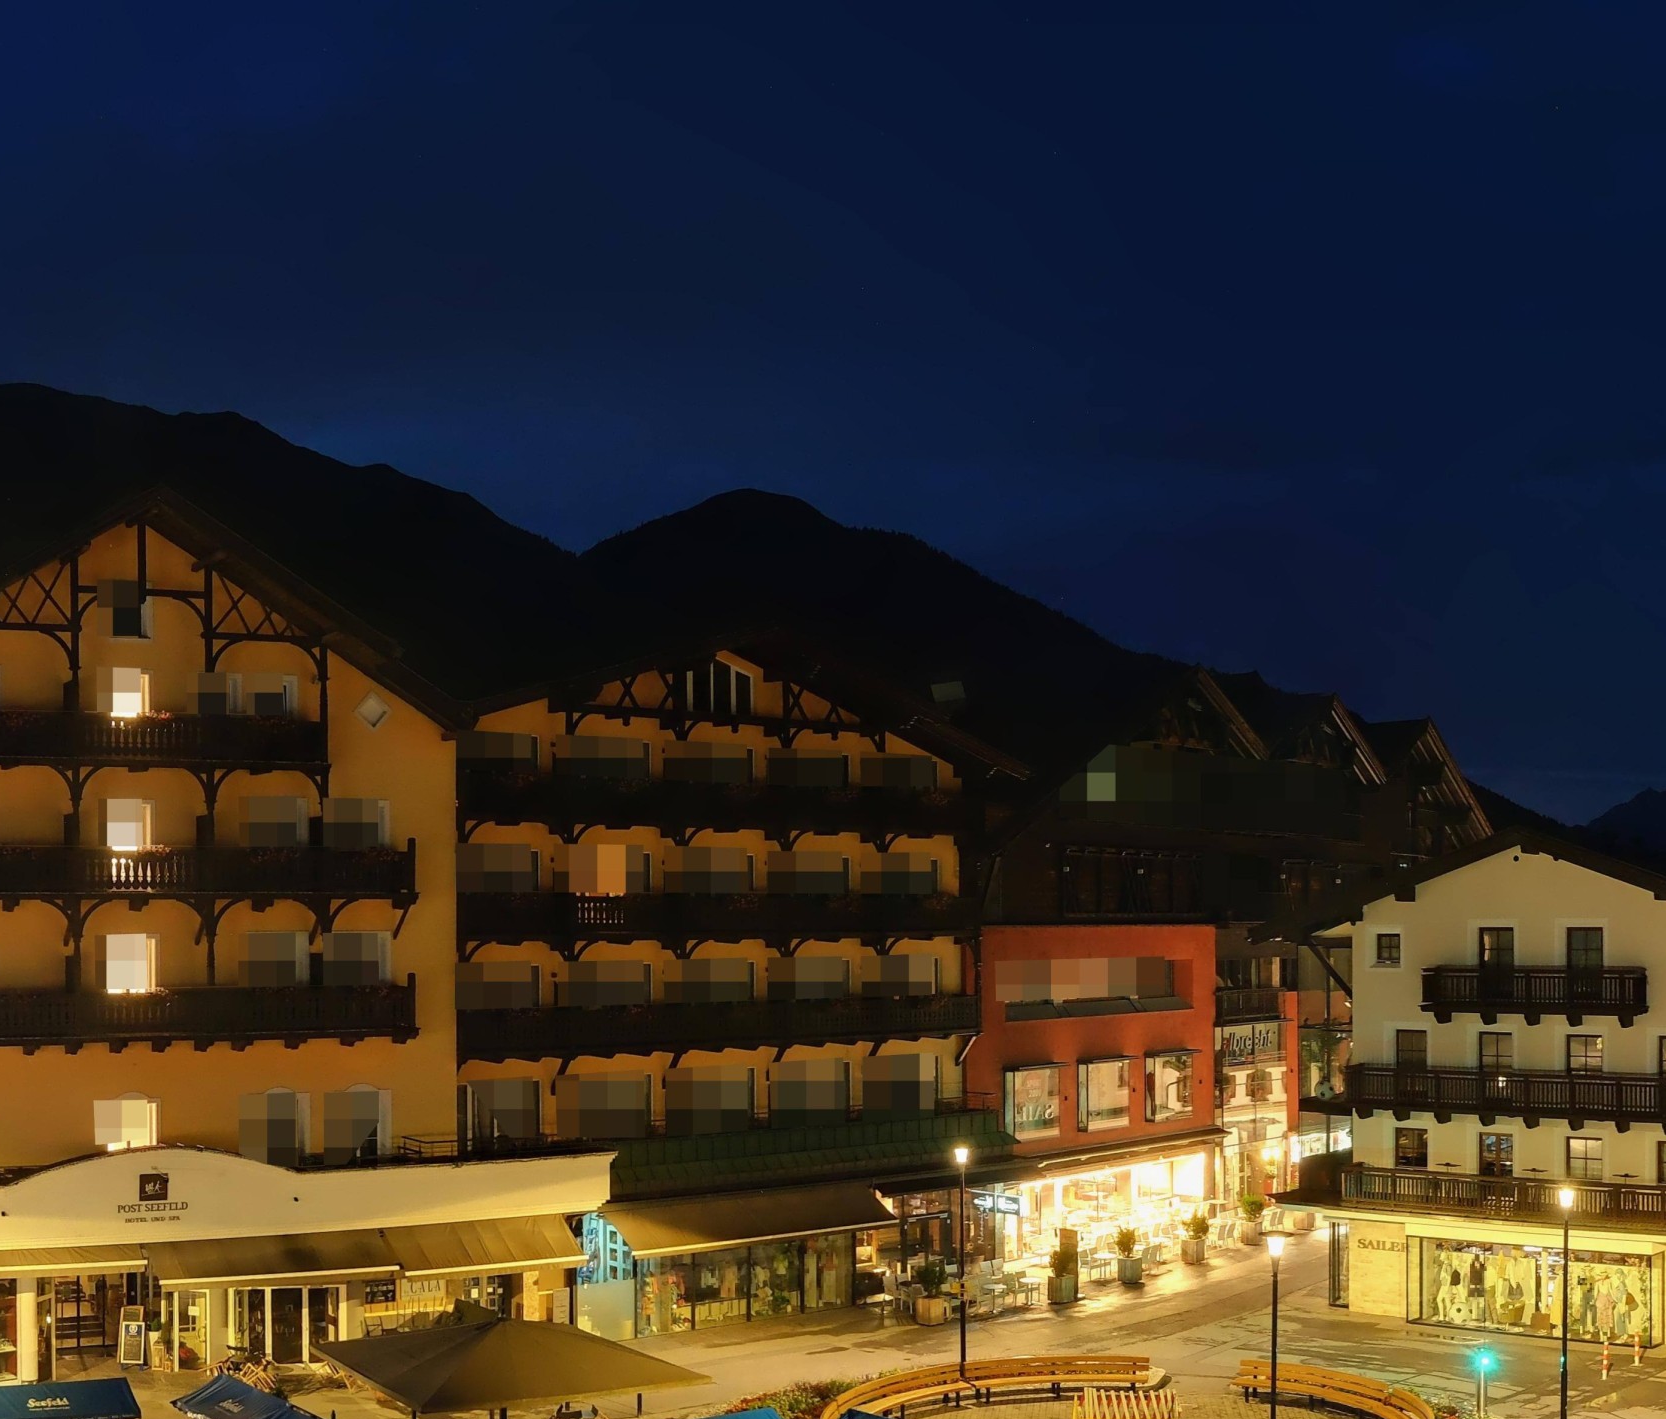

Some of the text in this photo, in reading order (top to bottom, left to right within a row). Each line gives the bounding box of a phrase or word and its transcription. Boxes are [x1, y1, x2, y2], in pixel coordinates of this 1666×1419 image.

[117, 1202, 189, 1214] POST SEEFELD
[124, 1216, 149, 1224] HOTEL
[26, 1397, 71, 1409] Seefeld
